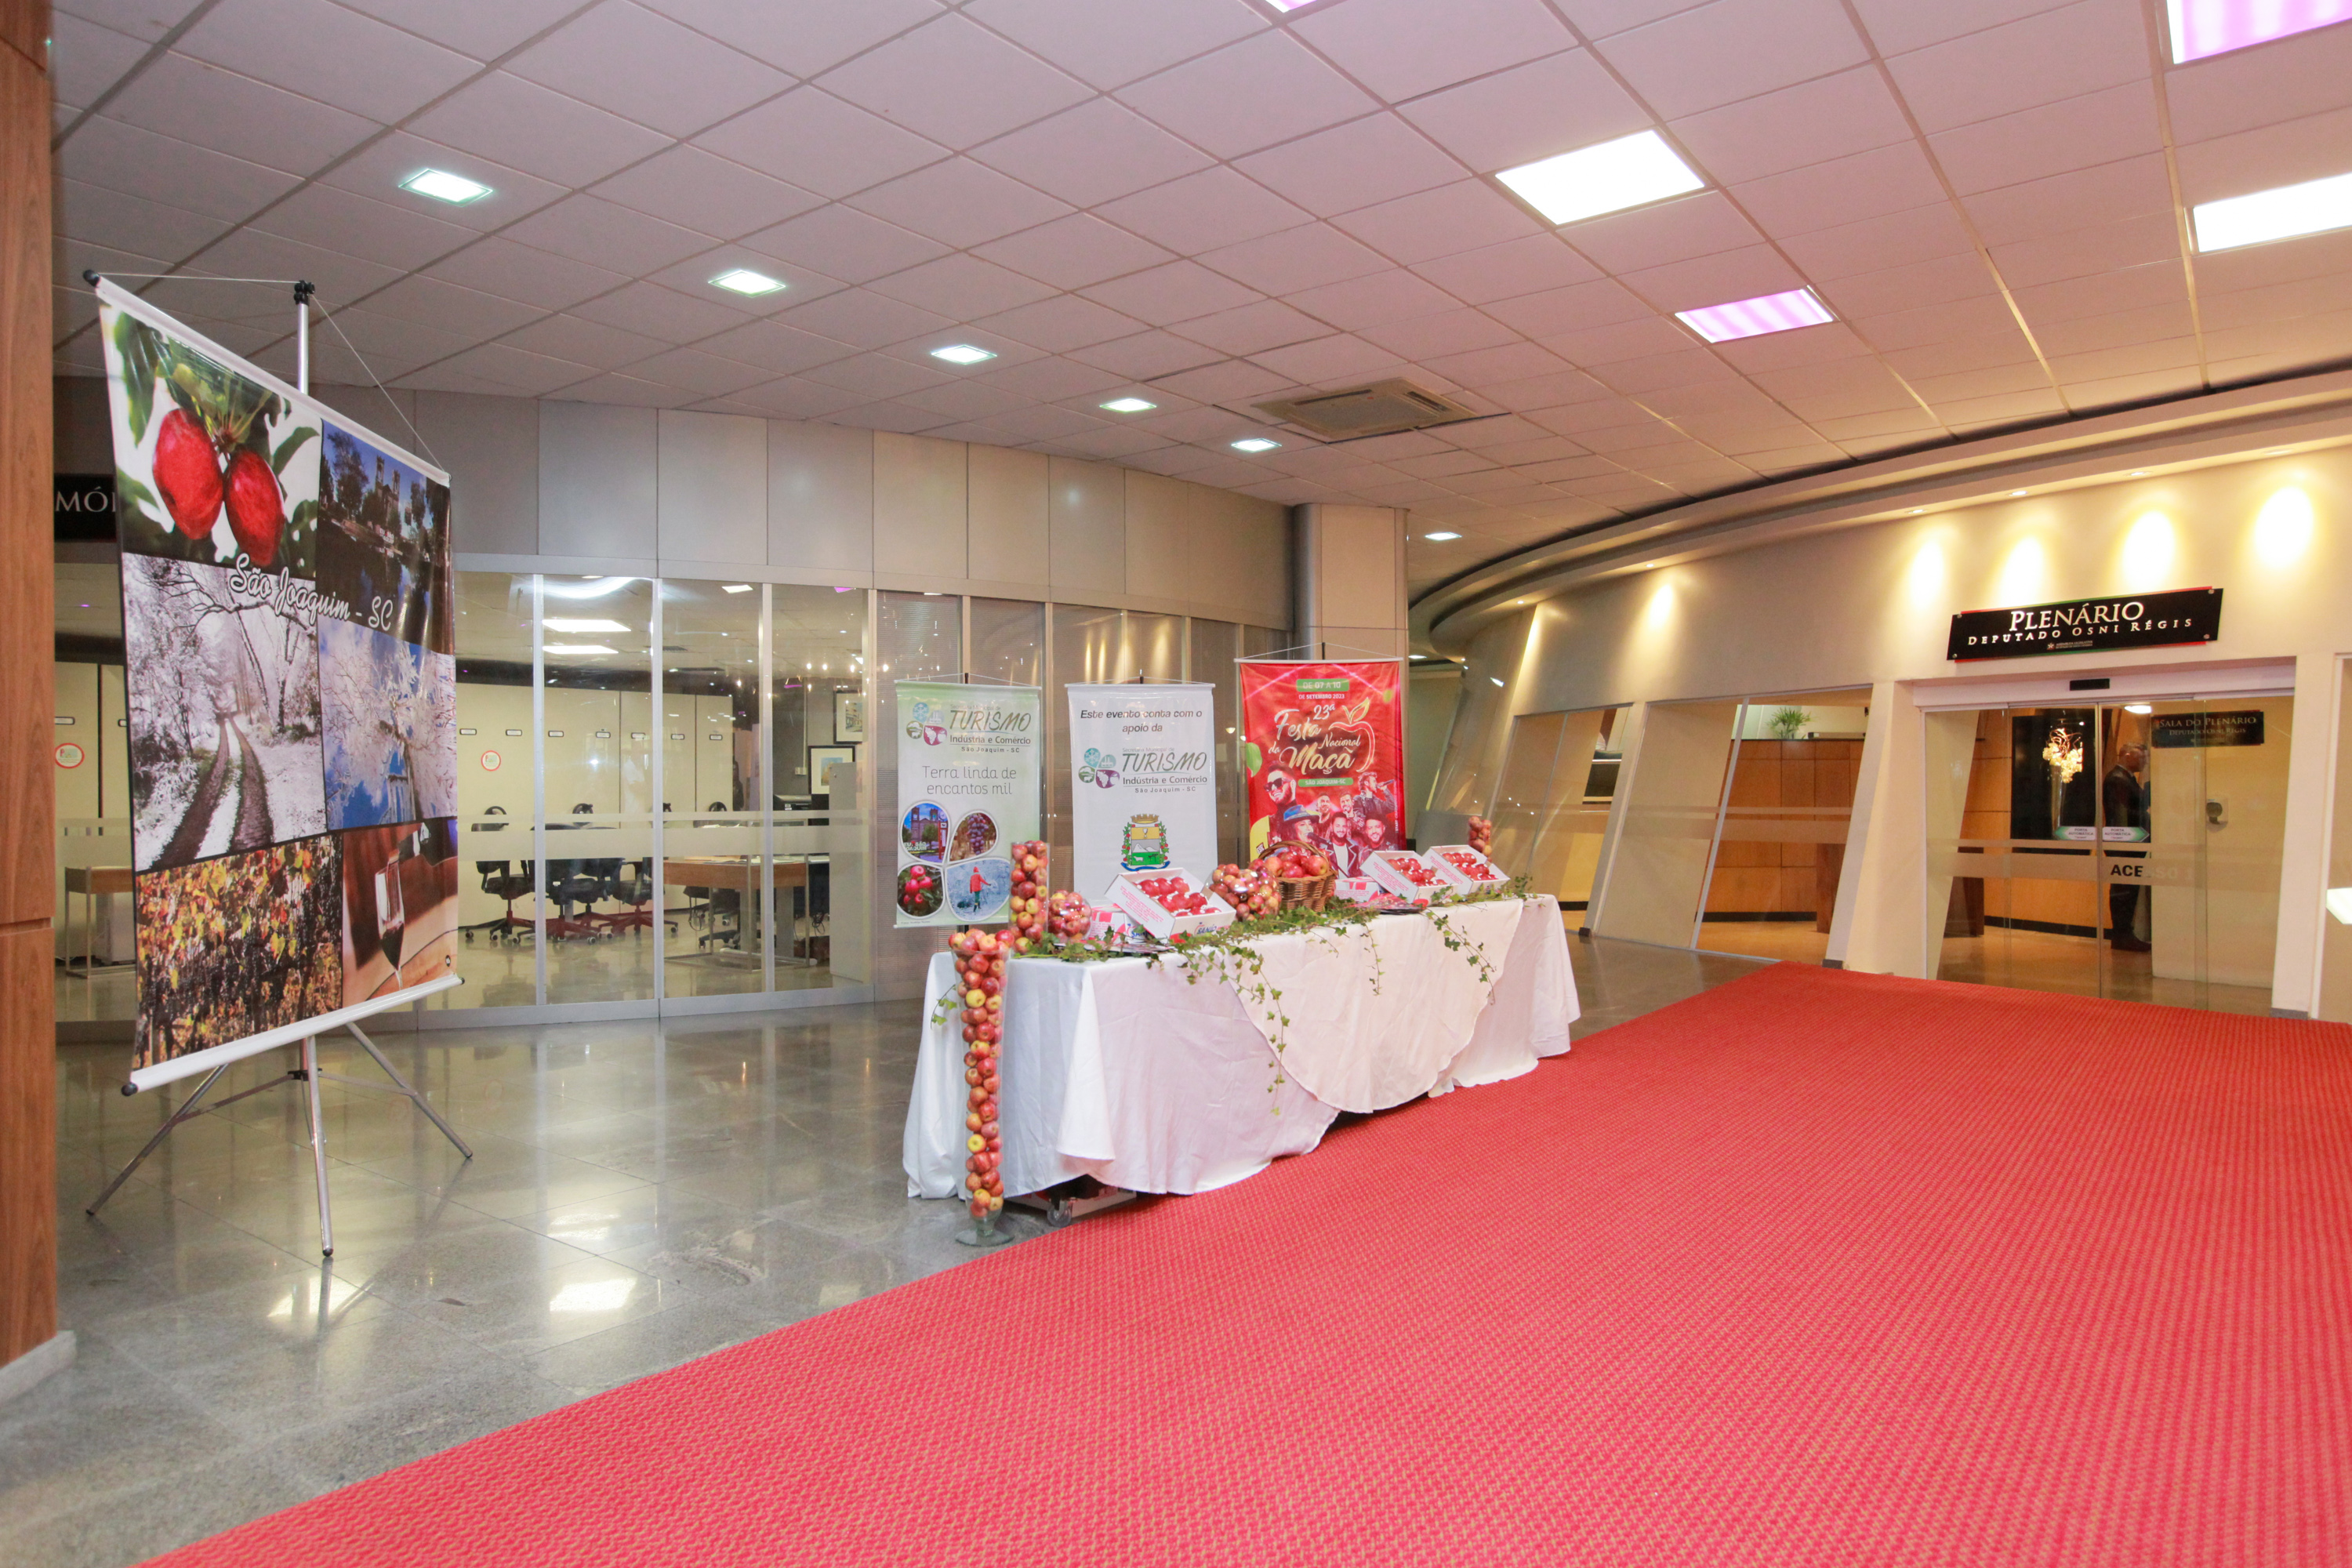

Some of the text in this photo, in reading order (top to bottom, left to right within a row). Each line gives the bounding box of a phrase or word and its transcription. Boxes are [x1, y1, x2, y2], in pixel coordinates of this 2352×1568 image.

[229, 553, 272, 599] São
[274, 566, 350, 626] Joaquim
[368, 596, 394, 631] SC
[2009, 601, 2144, 632] PLENÁRIO
[1968, 630, 2061, 645] DEPUTADO
[2072, 625, 2119, 637] OSNI
[2131, 619, 2192, 632] RÉGIS
[949, 710, 1032, 731] TURISMO
[1080, 710, 1104, 719] Este
[1106, 710, 1141, 719] evento
[1142, 710, 1171, 718] conta
[2205, 716, 2257, 725] PLENÁRIO
[1122, 723, 1163, 735] apoio da
[1274, 709, 1323, 742] Festa
[949, 735, 985, 744] Indústria
[995, 735, 1031, 745] Comércio
[1268, 742, 1281, 754] da
[1318, 732, 1361, 750] Nacional
[1122, 752, 1207, 772] TURISMO
[1279, 742, 1356, 775] Maçã
[922, 765, 1017, 779] Terra linda de
[1123, 776, 1159, 785] Indústria
[1169, 775, 1207, 784] Comércio
[927, 782, 1013, 795] encantos mil
